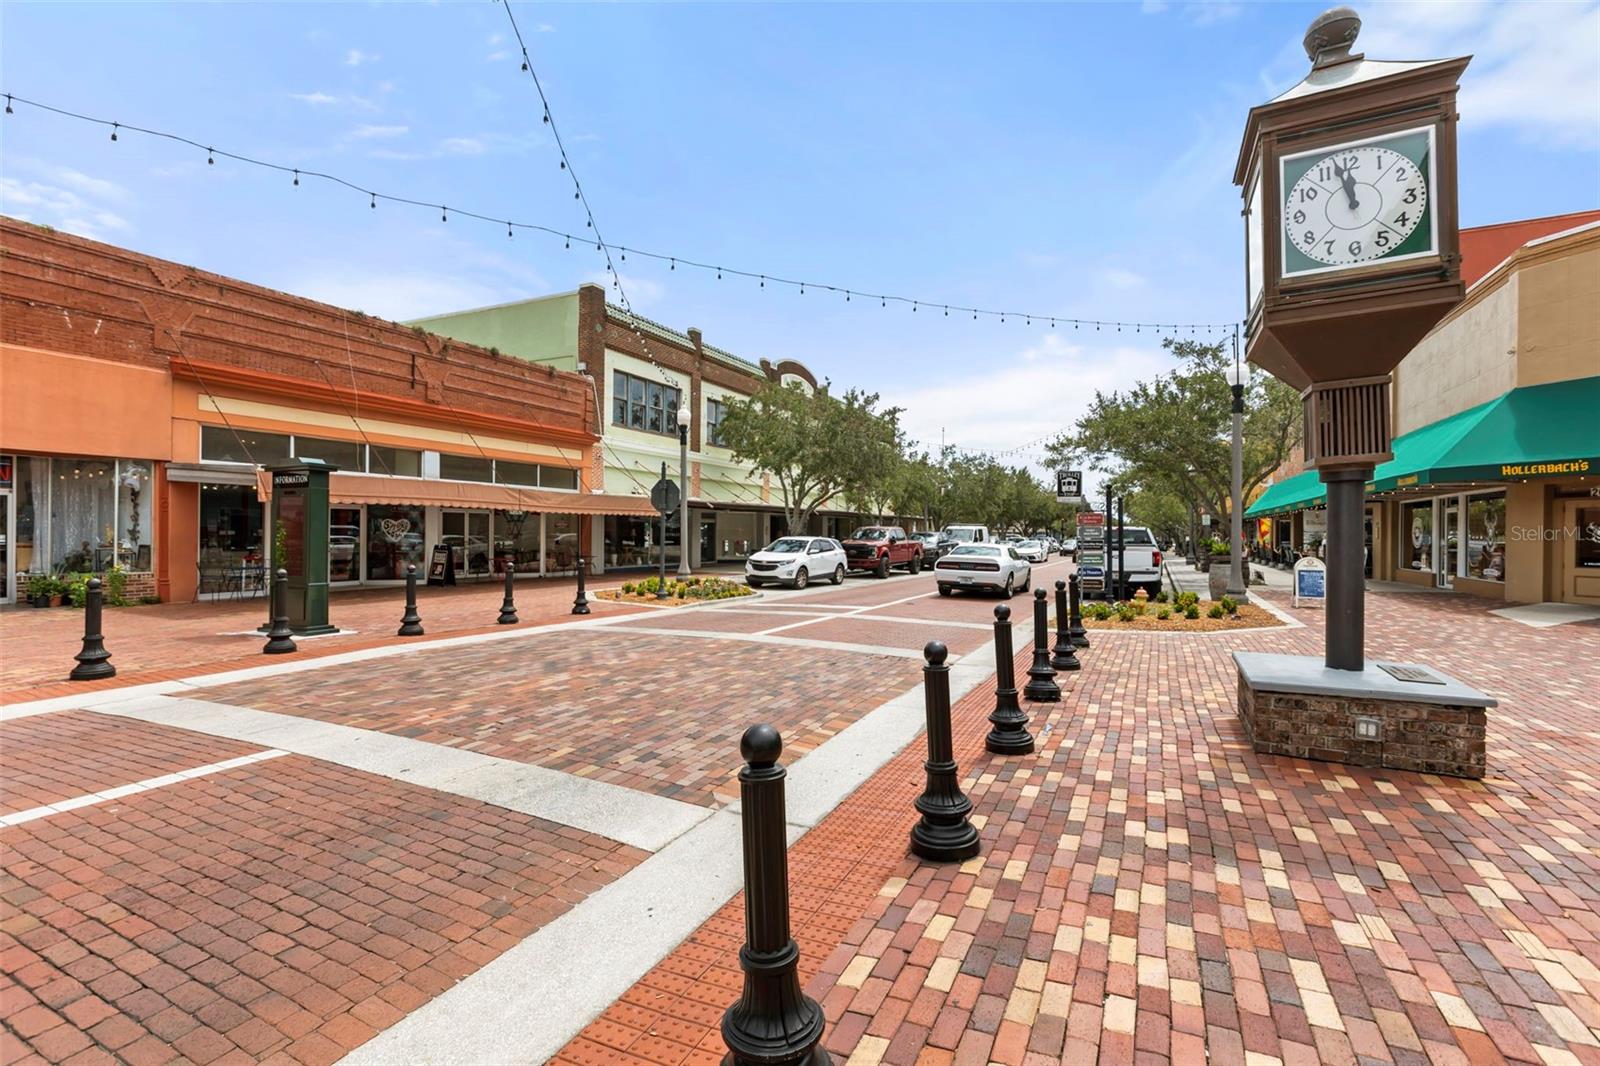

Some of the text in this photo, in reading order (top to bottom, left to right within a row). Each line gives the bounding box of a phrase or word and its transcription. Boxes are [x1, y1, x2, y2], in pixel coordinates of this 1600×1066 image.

[1343, 155, 1361, 170] 12
[1377, 155, 1382, 170] 1
[1319, 166, 1331, 182] 11
[1395, 167, 1408, 182] 2
[1300, 187, 1318, 203] 10
[1402, 187, 1417, 204] 3
[1293, 209, 1306, 224] 9
[1393, 211, 1410, 227] 4
[1303, 230, 1315, 245] 8
[1374, 230, 1390, 247] 5
[1324, 239, 1336, 256] 7
[1348, 240, 1362, 257] 6
[1502, 460, 1590, 476] HOLLERBACH'S
